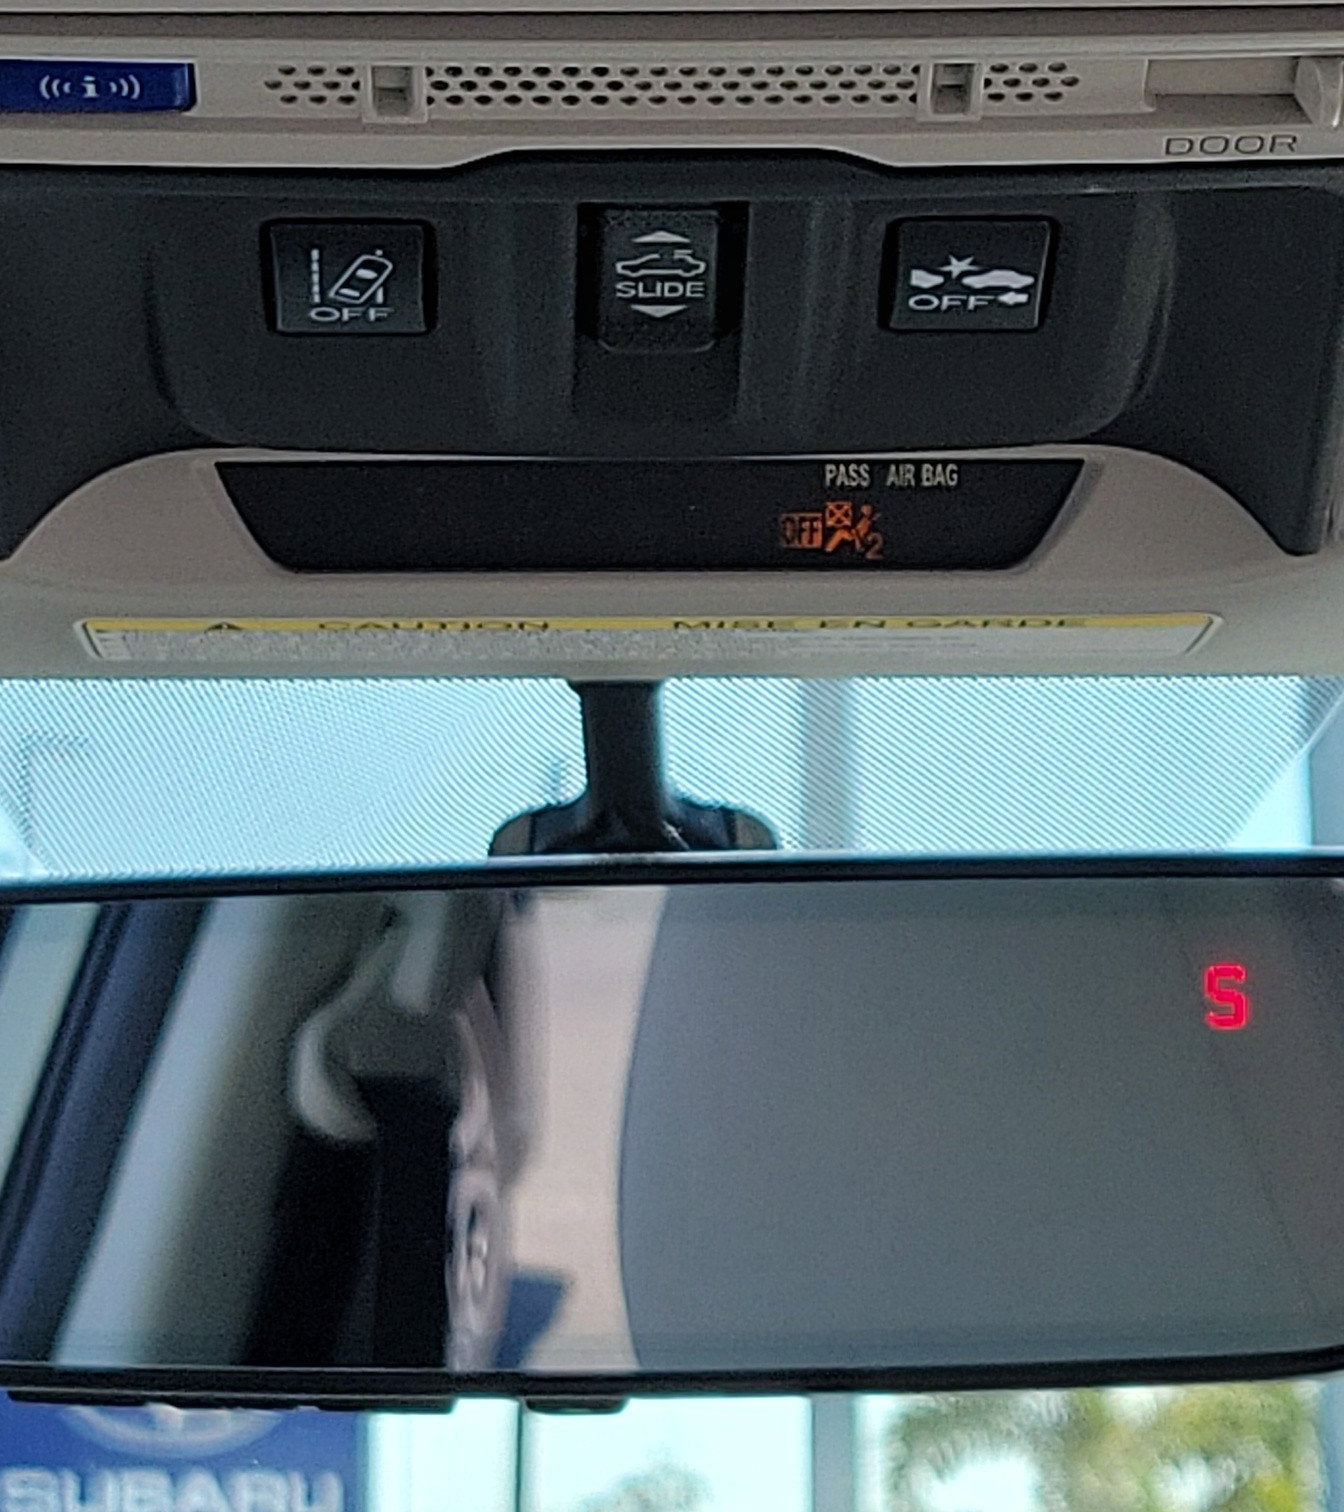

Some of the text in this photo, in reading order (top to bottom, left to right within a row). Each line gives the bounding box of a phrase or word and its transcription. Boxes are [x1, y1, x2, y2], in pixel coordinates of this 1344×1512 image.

[1164, 134, 1299, 157] DOOR
[615, 280, 706, 300] SLIDE
[908, 294, 997, 312] OFF
[309, 306, 393, 323] OFF
[824, 463, 959, 487] PASS AIR BAG
[317, 618, 1085, 631] CAUTION MISE EN GARDE
[1205, 962, 1249, 1031] S
